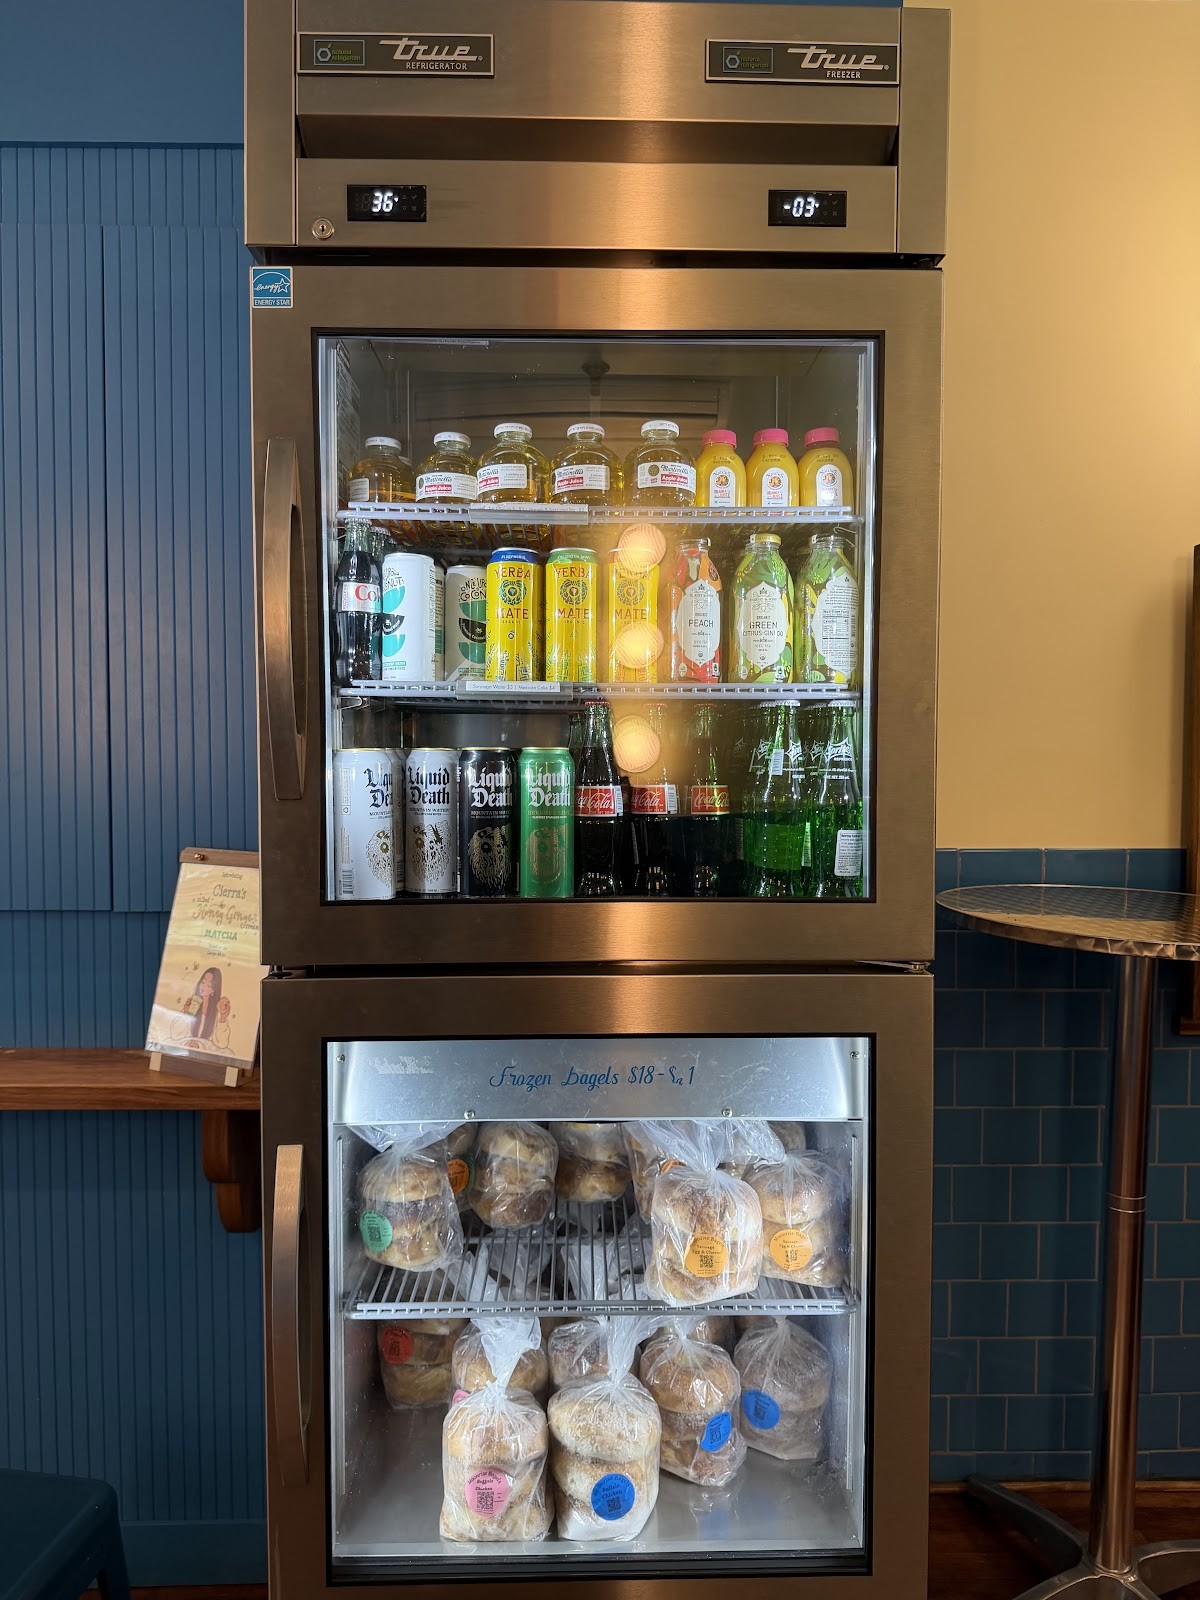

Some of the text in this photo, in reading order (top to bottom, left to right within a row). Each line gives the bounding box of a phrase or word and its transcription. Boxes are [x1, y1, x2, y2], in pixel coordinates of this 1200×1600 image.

[406, 62, 468, 70] REFRIGERATOR
[826, 71, 861, 79] FREEZER
[372, 191, 394, 213] 36
[494, 566, 532, 580] YERBA
[555, 566, 593, 579] YERBA
[496, 607, 530, 619] MATE
[557, 607, 592, 620] MATE
[615, 608, 648, 620] MATE
[688, 619, 714, 628] PEACH
[749, 621, 778, 629] GREEN
[407, 765, 450, 790] Liquid
[467, 766, 513, 792] Liquid
[524, 766, 571, 792] Liquid
[409, 785, 450, 805] Death
[471, 786, 513, 808] Death
[528, 786, 571, 808] Death
[213, 884, 247, 900] Cierra's
[204, 929, 238, 941] MATCHA
[489, 1066, 552, 1093] Frozen
[560, 1066, 620, 1092] Bagels
